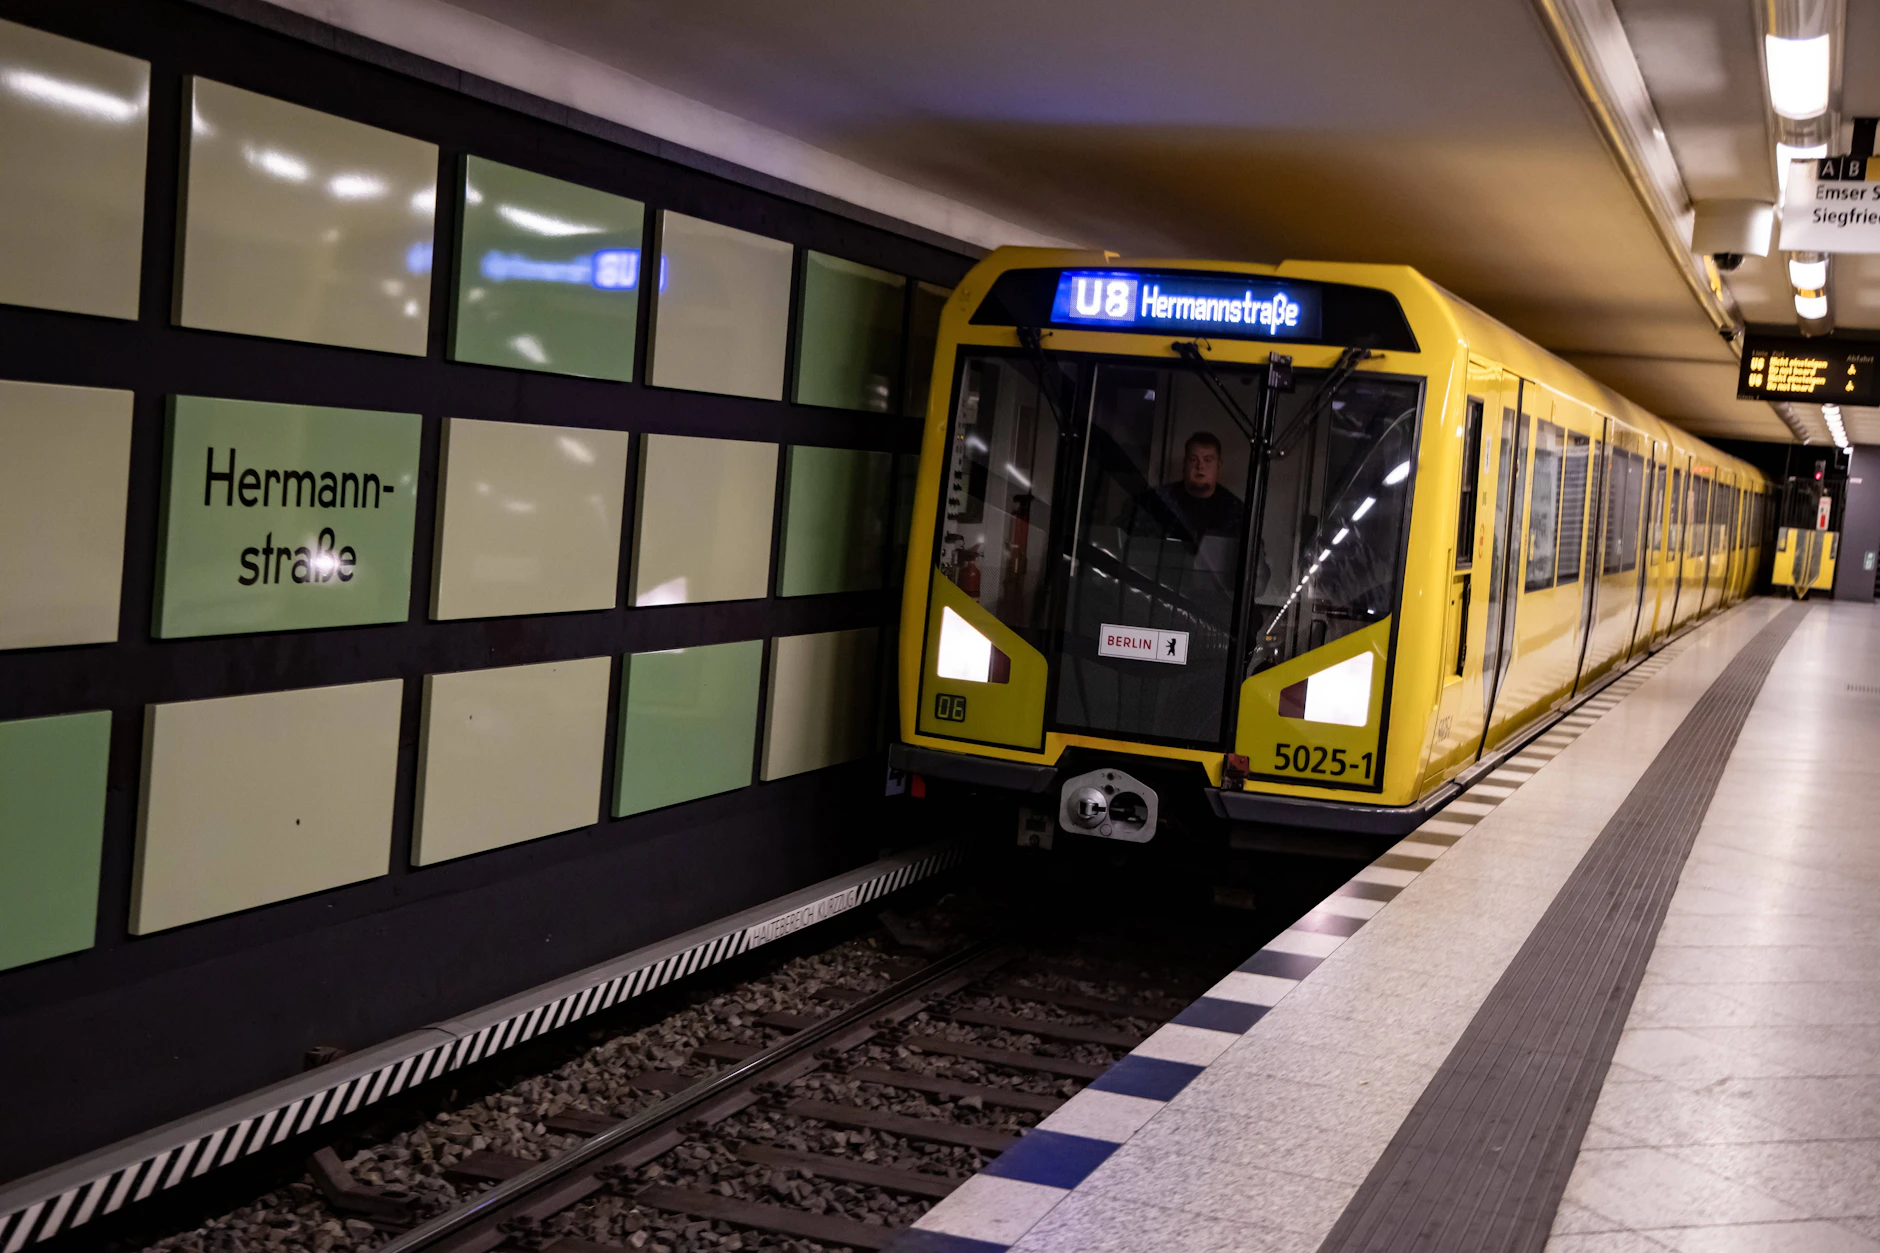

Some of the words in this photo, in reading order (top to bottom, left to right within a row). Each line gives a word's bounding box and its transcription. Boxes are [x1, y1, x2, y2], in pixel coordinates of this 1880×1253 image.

[1821, 160, 1834, 177] A
[1848, 161, 1860, 178] B
[1816, 184, 1867, 200] Emser
[1812, 207, 1880, 228] Siegfrie
[1076, 279, 1129, 318] U8
[1141, 285, 1298, 335] Hermannstraße
[204, 447, 394, 508] Hermann-
[238, 527, 357, 586] straße
[1107, 635, 1151, 651] BERLIN
[938, 696, 964, 720] 06
[1274, 743, 1373, 779] 5025-1
